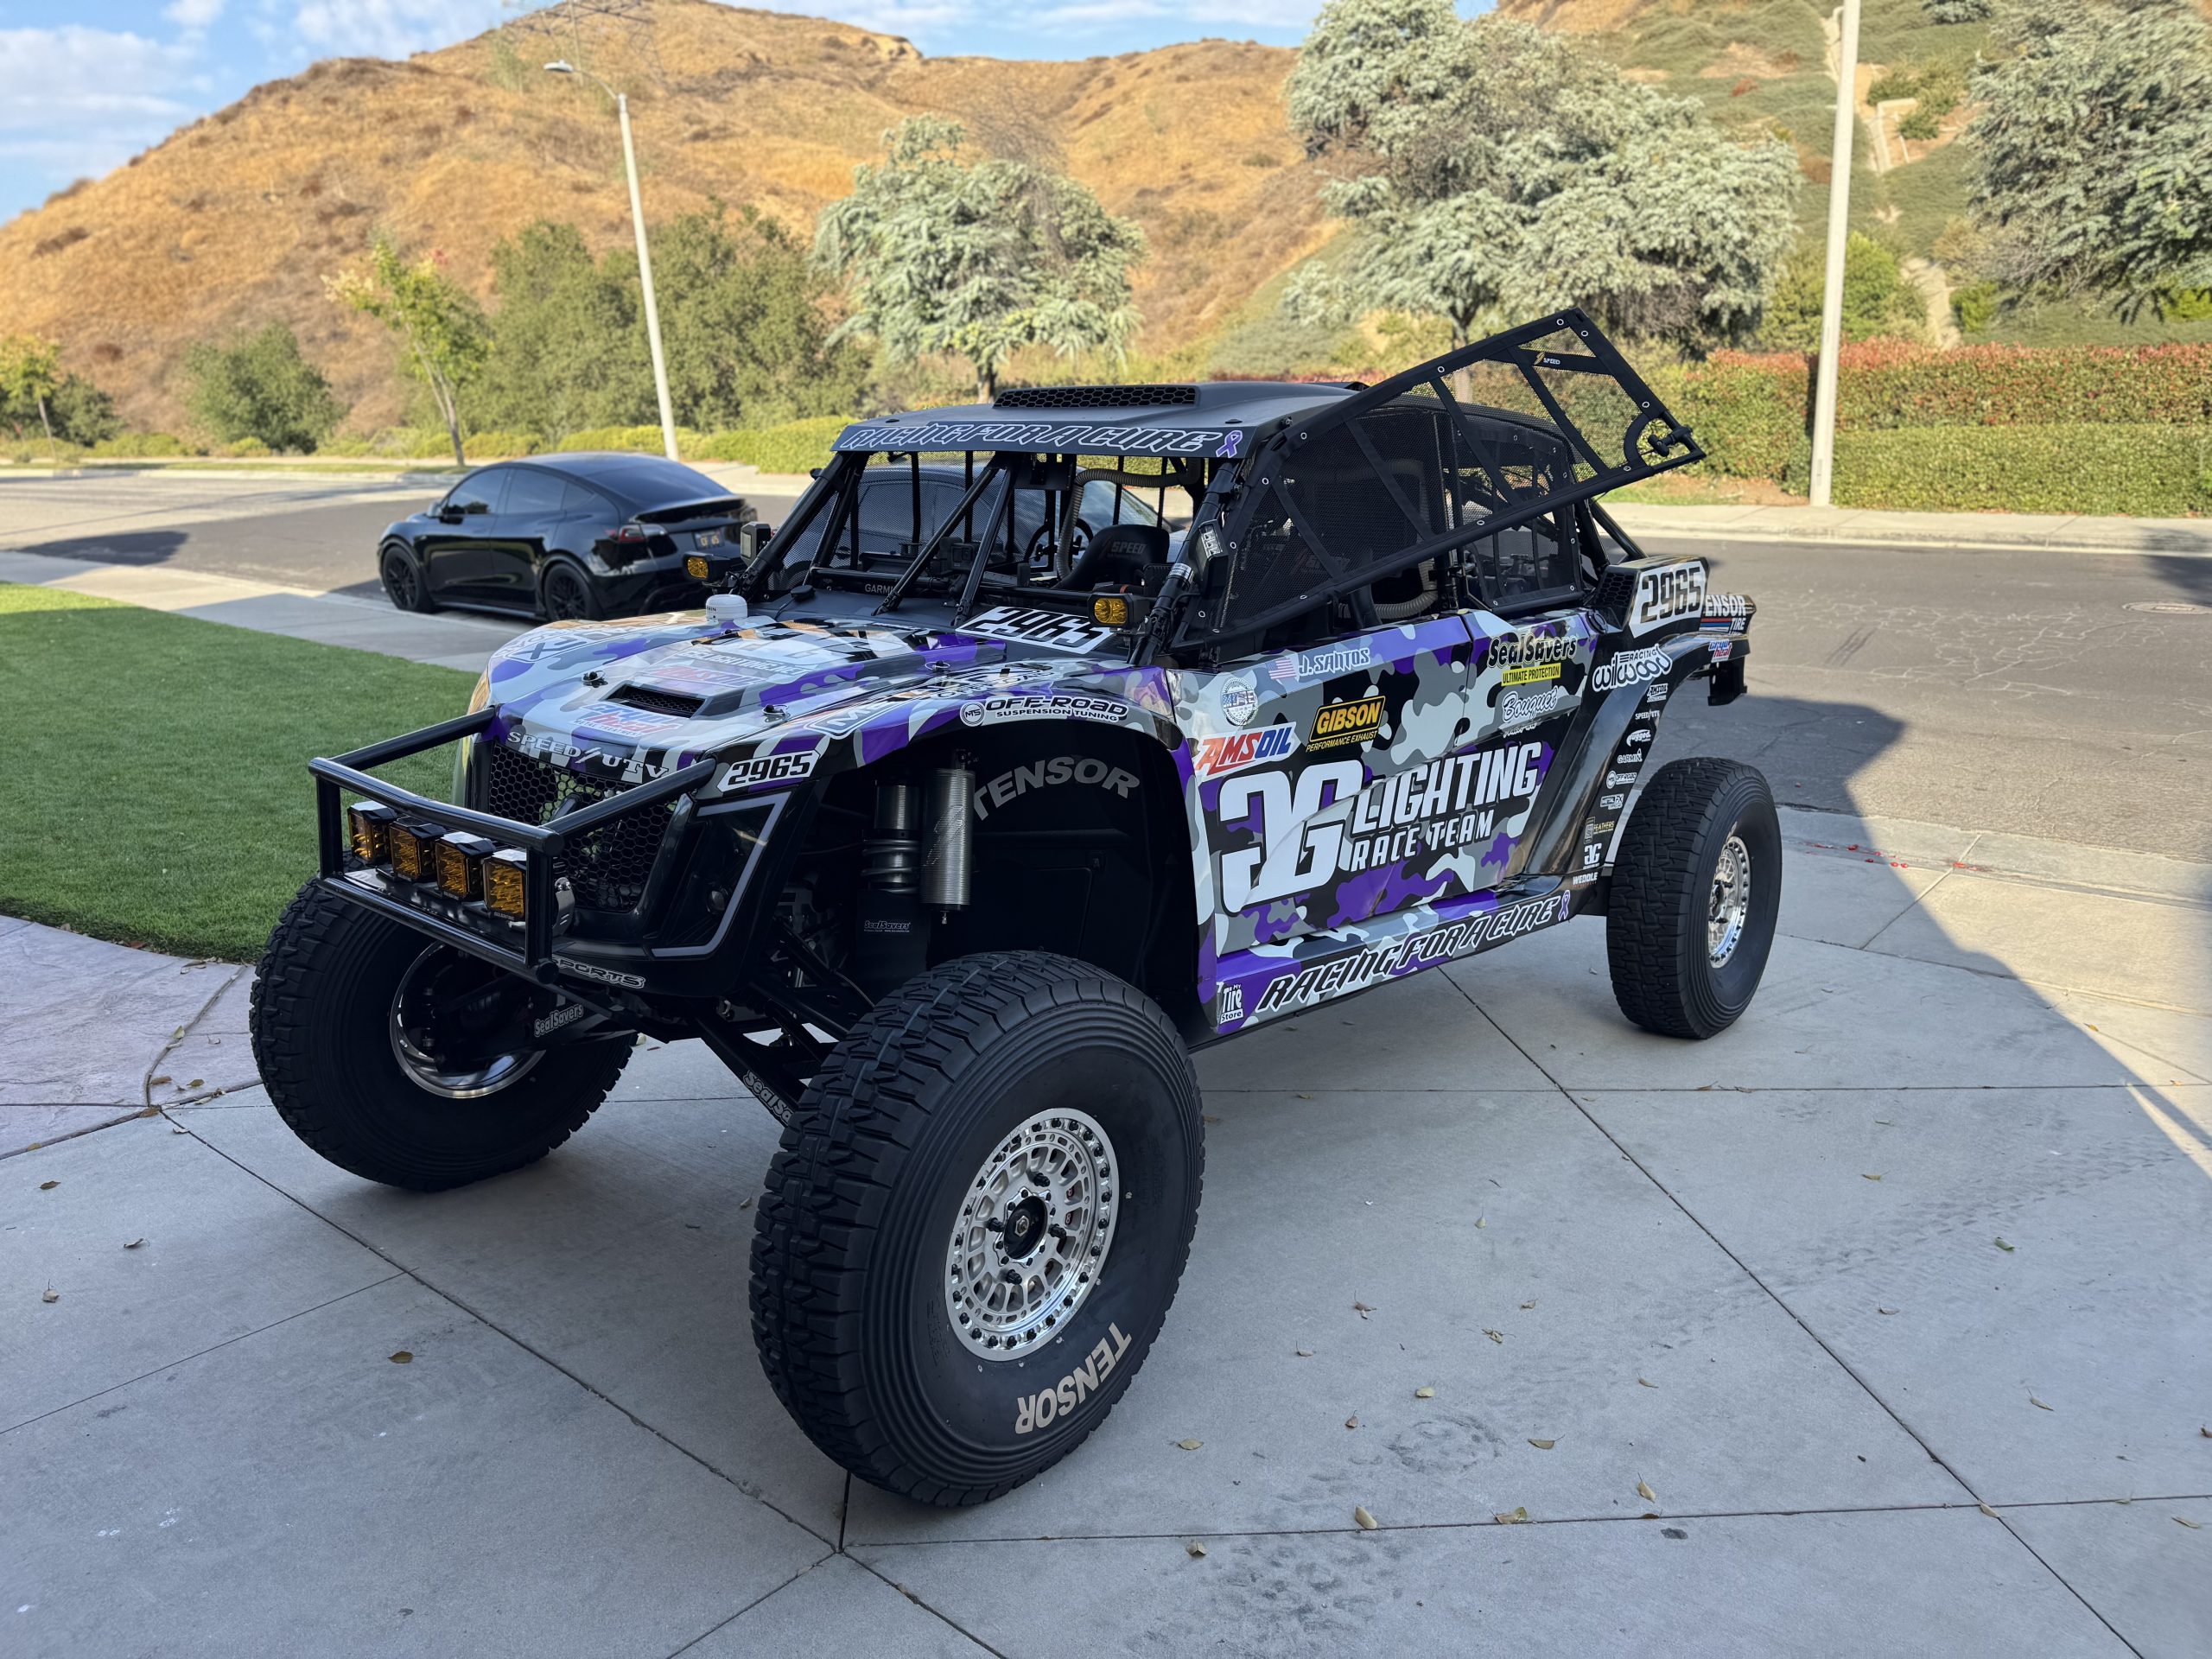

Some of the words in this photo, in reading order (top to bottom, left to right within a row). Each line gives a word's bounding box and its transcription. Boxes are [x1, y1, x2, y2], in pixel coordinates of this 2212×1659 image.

[840, 423, 973, 449] RACING
[958, 423, 1052, 446] FOR
[1035, 425, 1092, 447] A
[1078, 427, 1223, 453] CURE
[1111, 541, 1147, 555] SPEED
[865, 583, 895, 594] GARMI
[1640, 567, 1701, 624] 2965
[1705, 594, 1746, 617] ENSOR
[963, 607, 1104, 648] 2965
[1730, 618, 1746, 631] TIRE
[1593, 645, 1671, 690] wilwood
[1630, 650, 1657, 662] RACING
[1503, 670, 1528, 684] ULTIMATE
[1529, 665, 1560, 680] PROTECTION
[964, 709, 982, 718] MTS
[996, 709, 1071, 717] SUSPENSION
[1075, 710, 1118, 721] TUNING
[1316, 701, 1382, 734] GIBSON
[1503, 686, 1558, 722] Bouquet
[507, 731, 582, 758] SPEED
[601, 753, 670, 779] UTV
[1195, 726, 1293, 775] AMSOIL
[1306, 736, 1350, 753] PERFORMANCE
[1351, 731, 1378, 744] EXHAUST
[728, 752, 813, 785] 2965
[1618, 753, 1642, 764] GARMIN
[974, 756, 1140, 821] TENSOR
[1352, 741, 1542, 835] LIGHTING
[1351, 827, 1420, 873] RACE
[1431, 810, 1494, 852] TEAM
[1593, 821, 1615, 831] FEATHERS
[1573, 872, 1599, 885] WEDDLE
[1255, 943, 1403, 1012] RACING
[1396, 923, 1467, 969] FOR
[1459, 914, 1492, 950] A
[1485, 894, 1561, 941] CURE
[1223, 987, 1243, 1013] Tire
[534, 1003, 584, 1037] SealSavers
[1221, 1011, 1242, 1022] Store
[743, 1071, 793, 1125] SealSa
[1014, 1322, 1133, 1434] TENSOR
